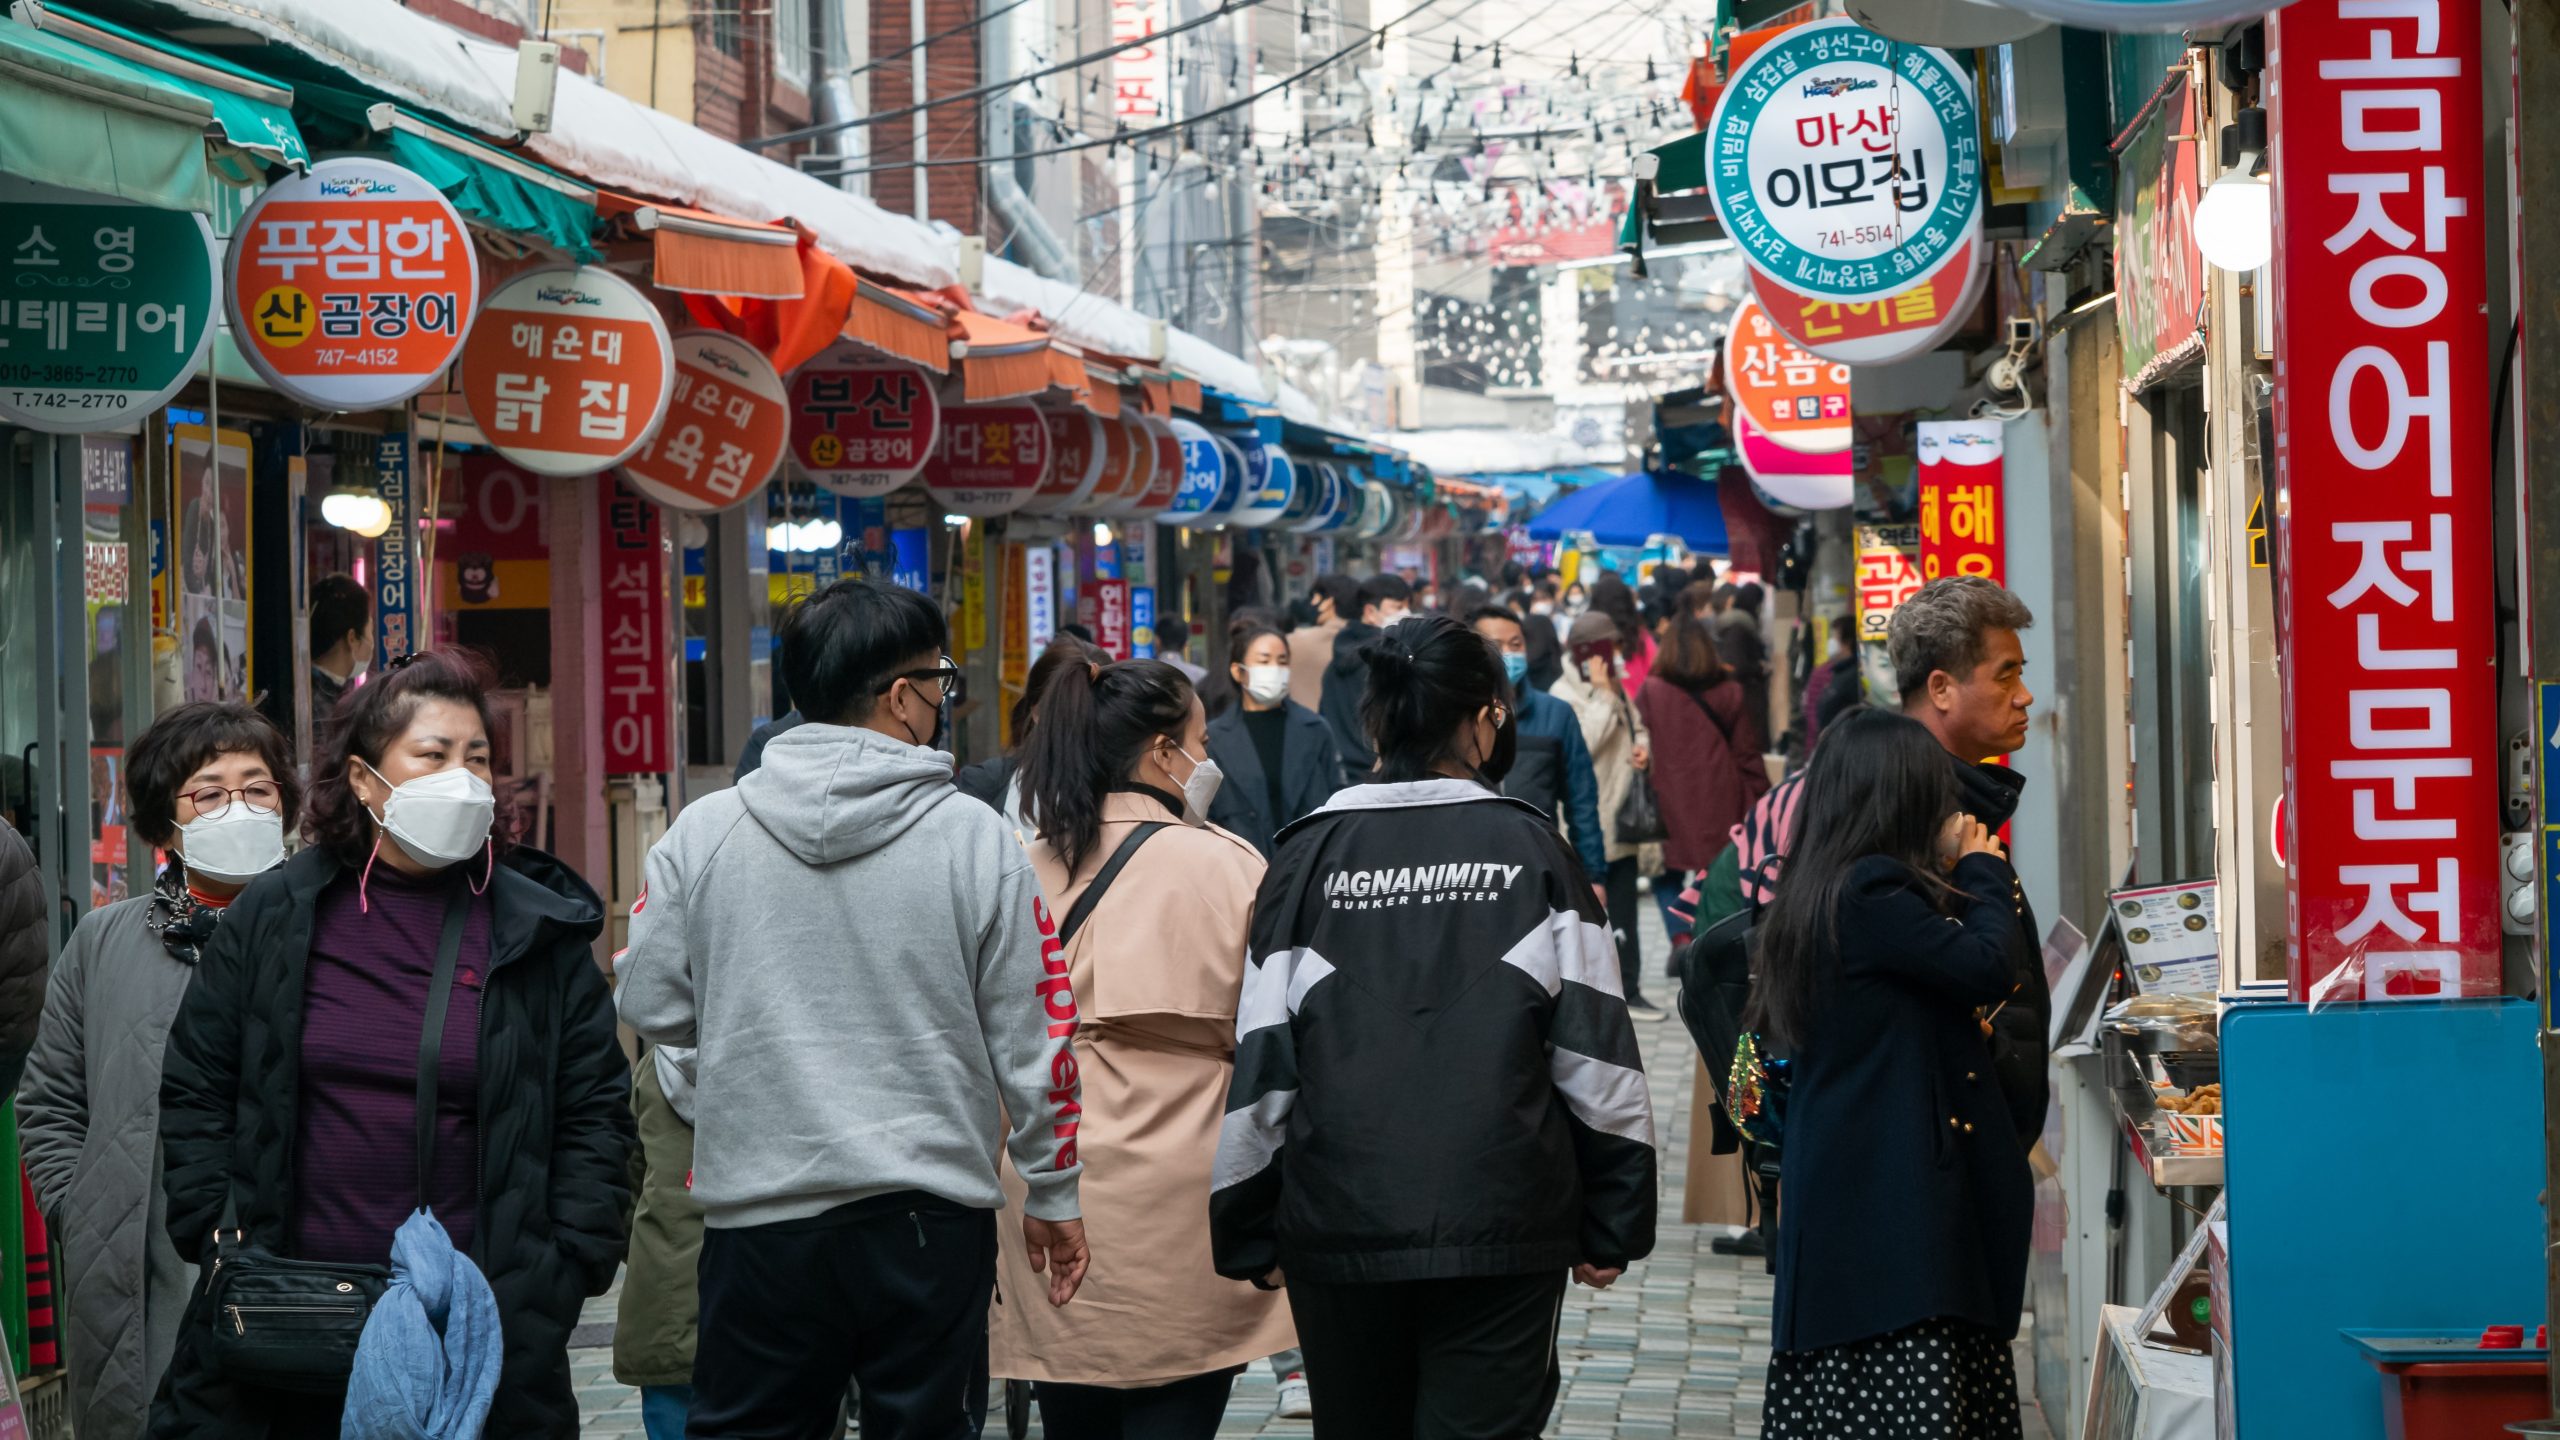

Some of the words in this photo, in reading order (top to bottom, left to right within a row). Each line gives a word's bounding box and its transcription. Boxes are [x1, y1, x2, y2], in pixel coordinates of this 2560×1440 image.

[1744, 50, 1798, 102] 삼겹살
[1904, 52, 1967, 123] 해물파전
[1721, 115, 1750, 177] 비빔밥
[1796, 105, 1895, 152] 마산
[1766, 148, 1928, 213] 이모집
[1941, 136, 1976, 219] 두루치기
[257, 217, 451, 281] 푸짐한
[1726, 190, 1787, 265] 김치찌개
[1817, 225, 1893, 249] 741-5514
[1892, 226, 1949, 276] 동태탕
[1796, 256, 1879, 288] 된장찌개
[260, 293, 305, 338] 산
[319, 292, 457, 338] 곰장어
[315, 348, 398, 366] 747-4152
[511, 322, 623, 366] 해운대
[0, 363, 138, 384] 010-3865-2770
[12, 391, 128, 409] T.742-2770
[802, 375, 919, 431] 부산
[641, 424, 754, 498] 육점
[815, 438, 837, 462] 산
[845, 437, 913, 463] 곰장어
[608, 561, 656, 765] 석쇠구이
[1331, 895, 1409, 910] BUNKER
[1422, 891, 1499, 904] BUSTER
